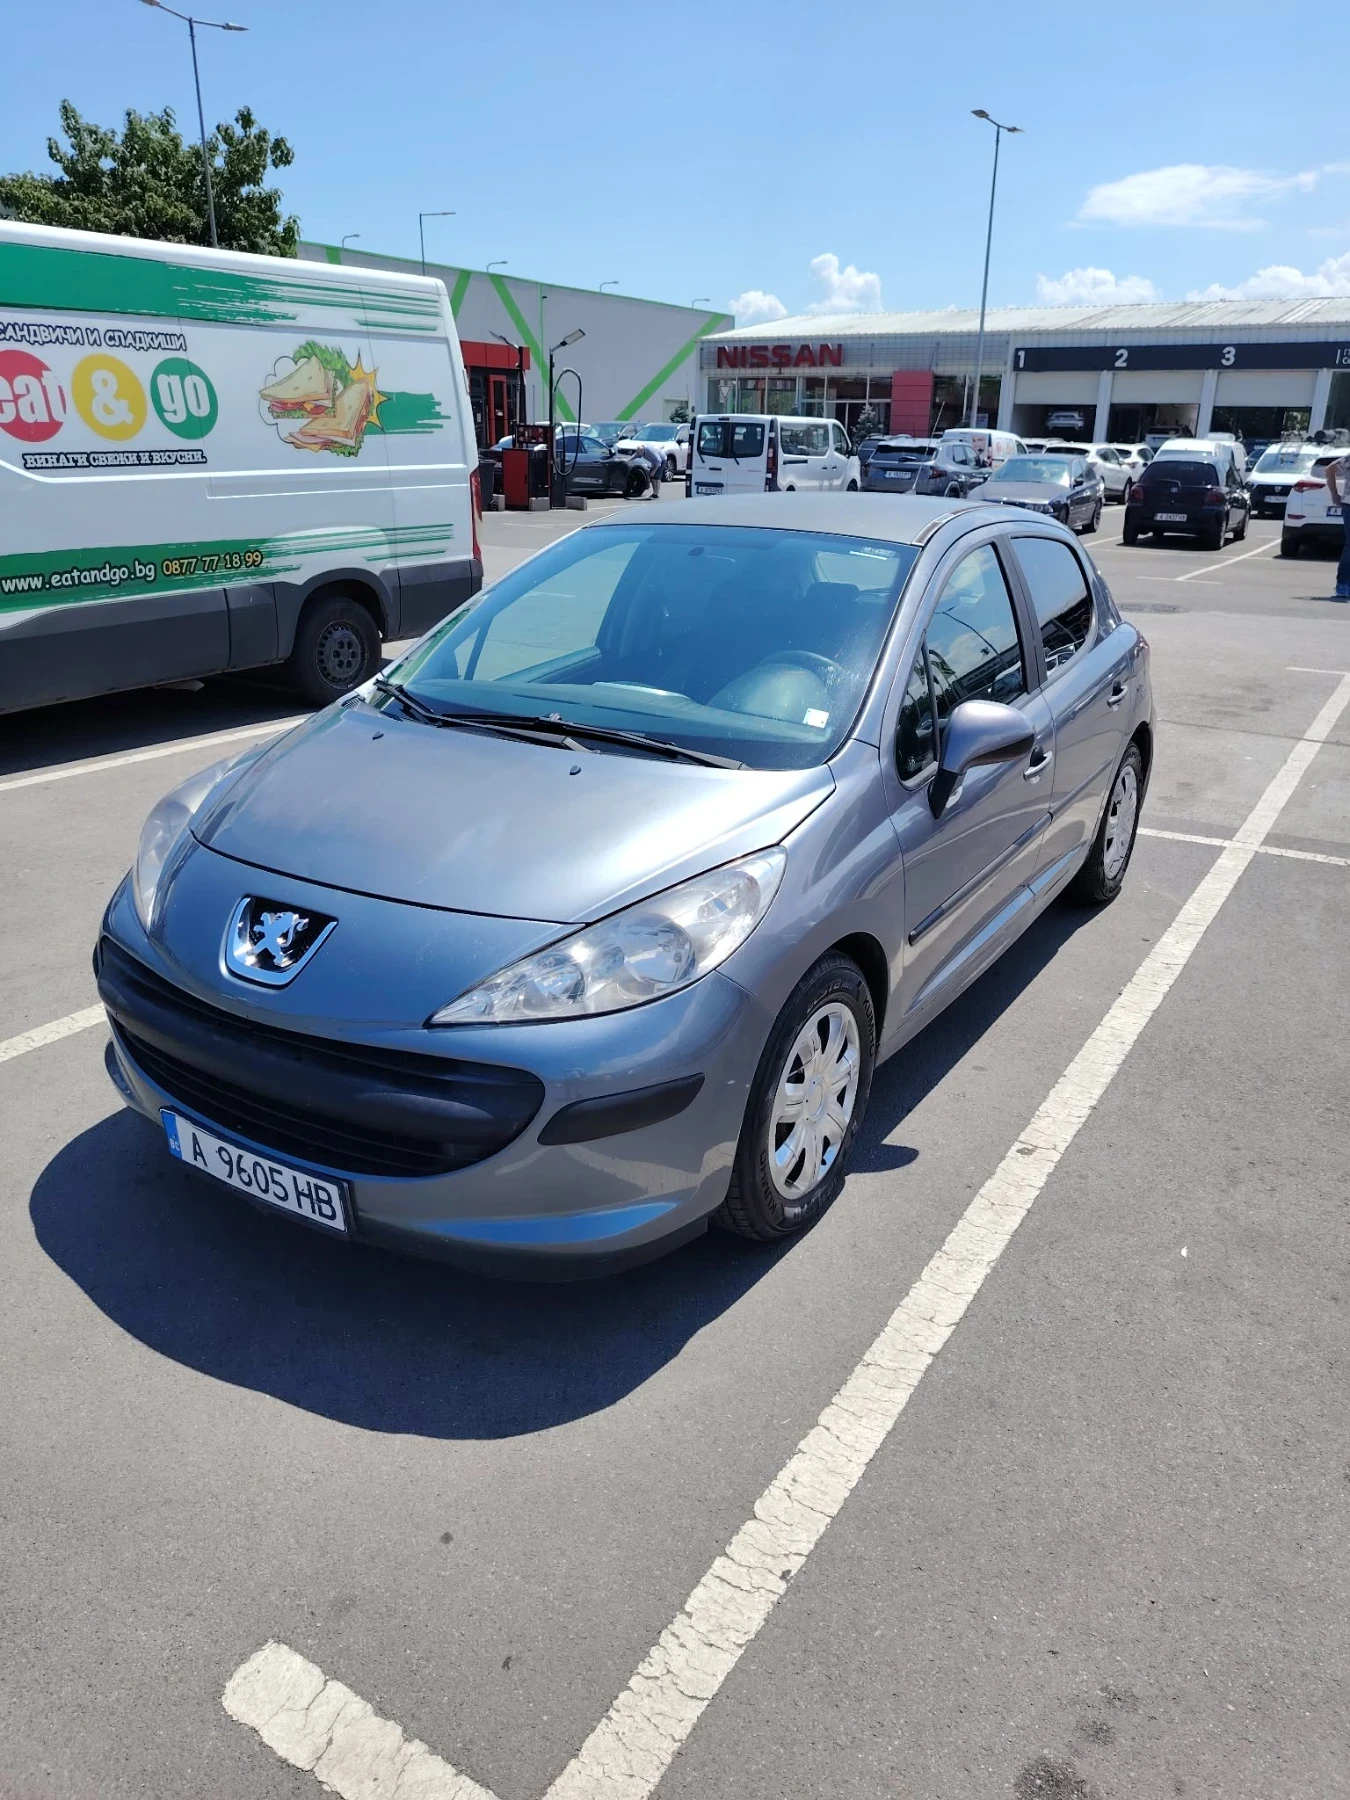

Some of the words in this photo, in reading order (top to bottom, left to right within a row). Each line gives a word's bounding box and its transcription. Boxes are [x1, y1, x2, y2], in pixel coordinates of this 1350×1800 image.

[86, 328, 101, 345] И
[104, 329, 187, 351] СЛАДКИШИ
[717, 343, 842, 368] NISSAN
[1018, 350, 1026, 368] 1
[1114, 348, 1129, 367] 2
[1221, 346, 1236, 366] 3
[92, 369, 134, 427] &
[157, 374, 210, 424] go
[24, 453, 88, 468] ВИНАГИ
[89, 452, 139, 466] СВЕЖИ
[2, 561, 155, 593] www.eatandgo.bg
[163, 558, 197, 575] 0877
[202, 555, 219, 571] 77
[225, 553, 241, 568] 18
[245, 552, 262, 566] 99
[192, 1131, 208, 1167] A
[216, 1145, 289, 1202] 9605
[293, 1175, 337, 1221] HB
